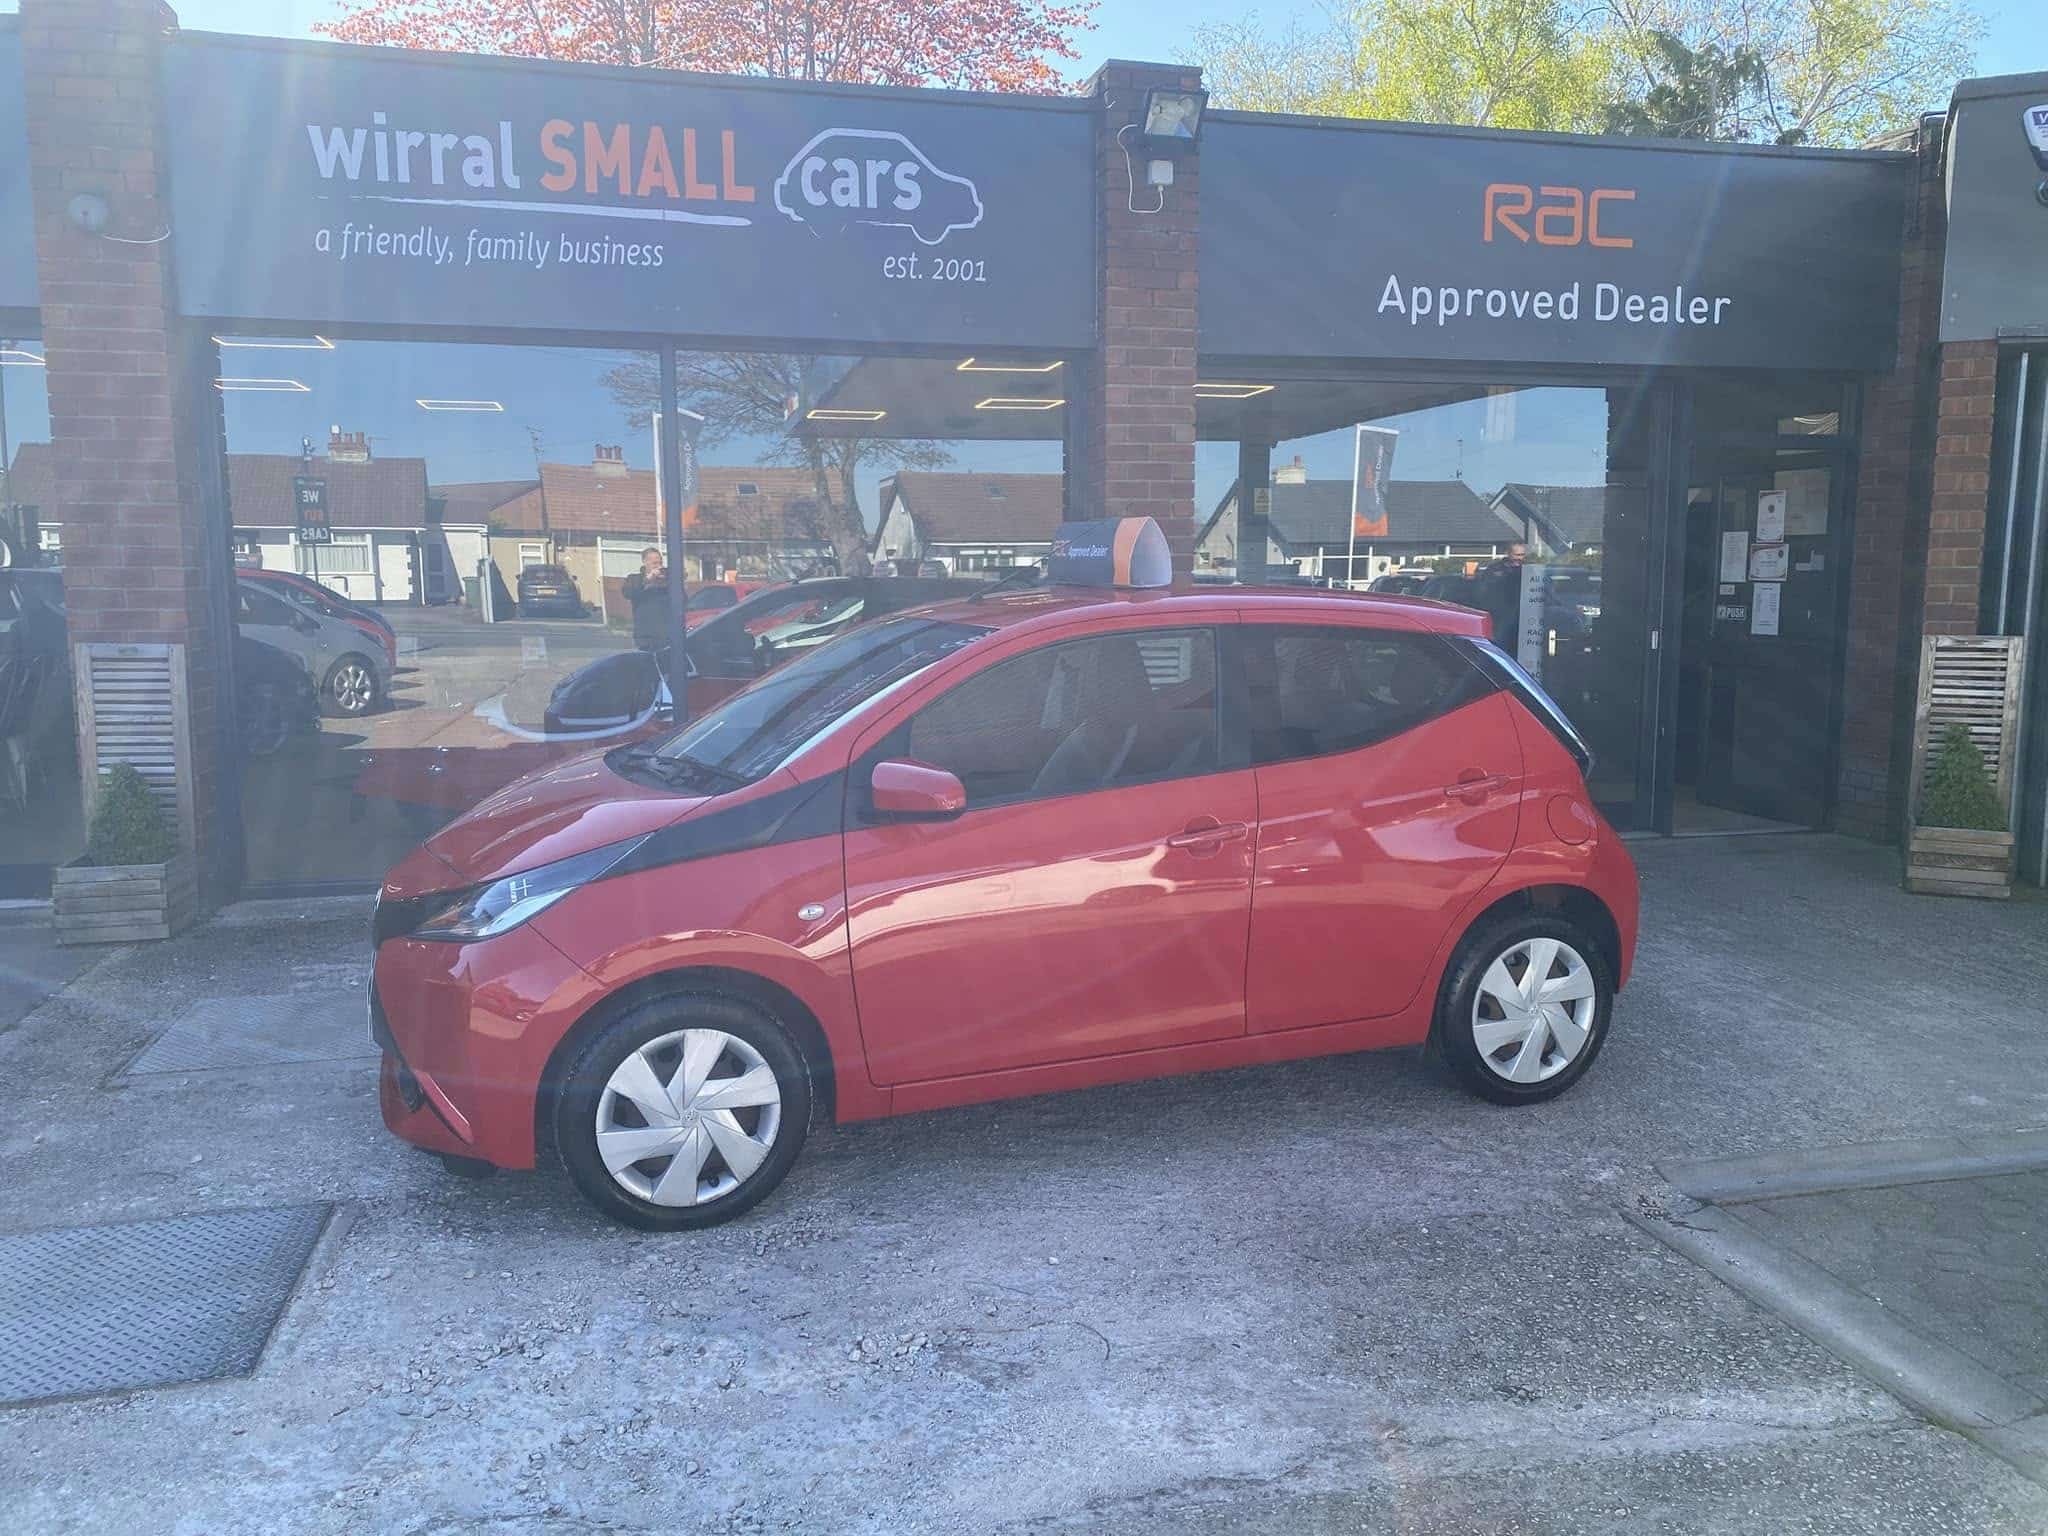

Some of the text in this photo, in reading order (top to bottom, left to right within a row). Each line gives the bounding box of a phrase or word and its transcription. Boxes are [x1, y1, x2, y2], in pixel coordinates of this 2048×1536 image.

[306, 111, 922, 211] wirral SMALL cars
[315, 222, 664, 269] a friendly, family business
[883, 251, 987, 282] est. 2001
[1377, 274, 1732, 326] Approved Dealer
